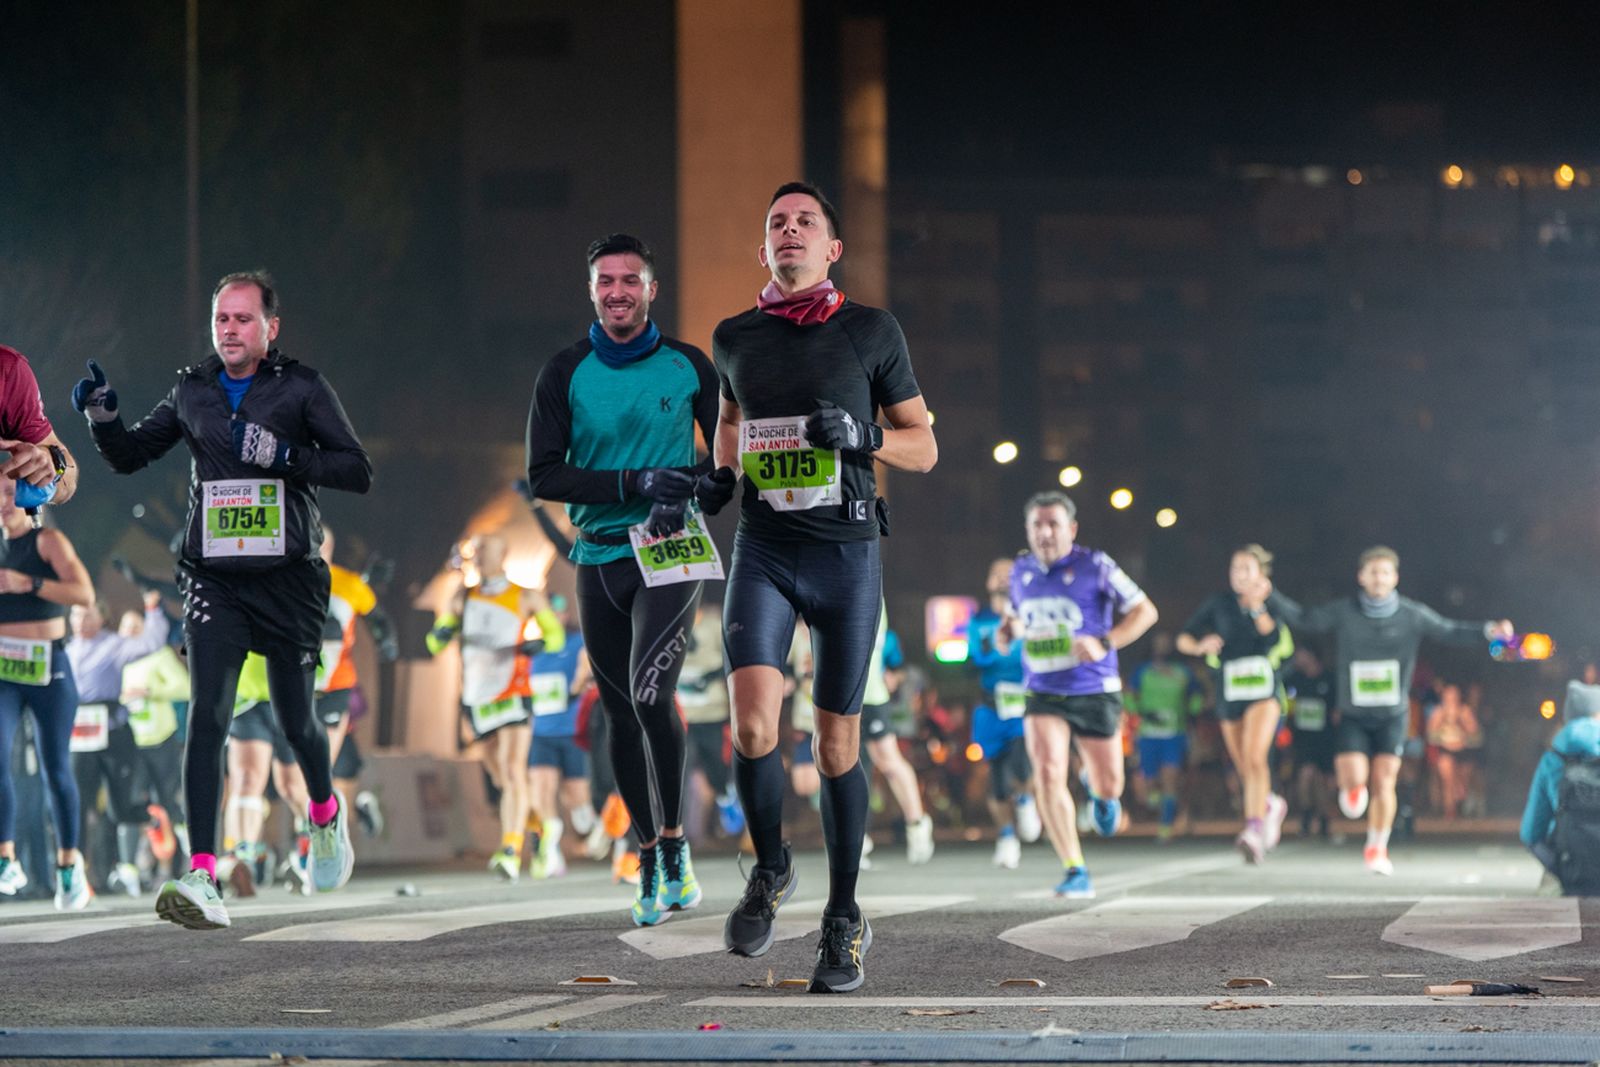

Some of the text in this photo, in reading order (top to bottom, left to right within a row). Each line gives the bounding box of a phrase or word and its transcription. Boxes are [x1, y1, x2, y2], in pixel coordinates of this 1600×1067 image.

[758, 428, 787, 439] NOCHE
[788, 427, 799, 437] DE
[748, 441, 766, 452] SAN
[759, 450, 817, 480] 3175
[219, 487, 252, 497] NOCHE DE
[212, 497, 225, 507] SAN
[218, 507, 268, 530] 6754
[650, 535, 705, 564] 3859
[637, 626, 688, 706] SPORT
